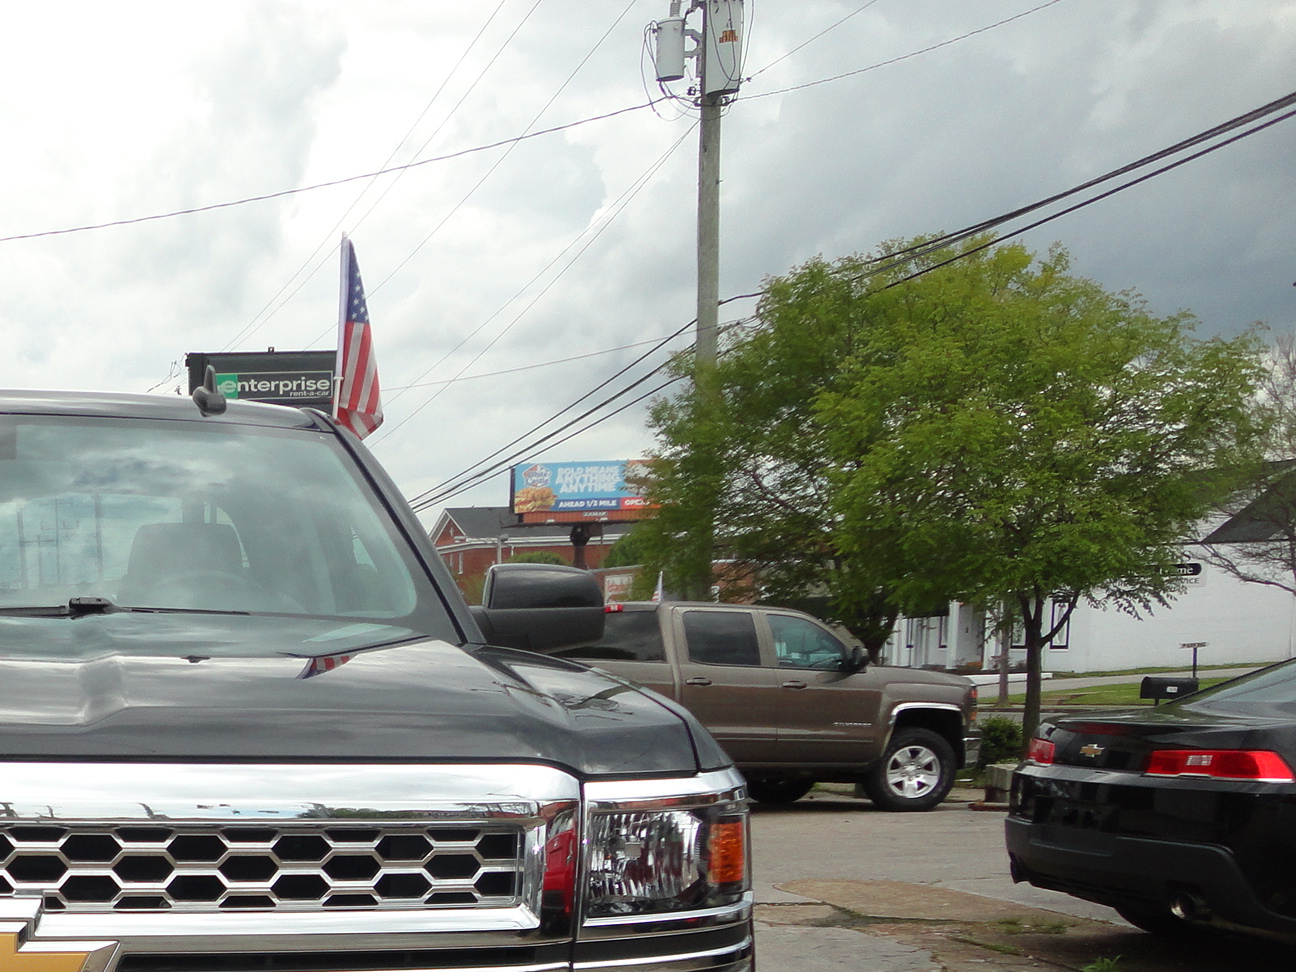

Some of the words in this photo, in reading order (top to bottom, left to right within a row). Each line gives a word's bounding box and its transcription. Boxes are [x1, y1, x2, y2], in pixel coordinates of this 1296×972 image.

[217, 376, 330, 395] enterprise
[555, 471, 621, 485] ANYTHING
[559, 482, 616, 493] ANYTIME
[558, 500, 585, 508] AHEAD
